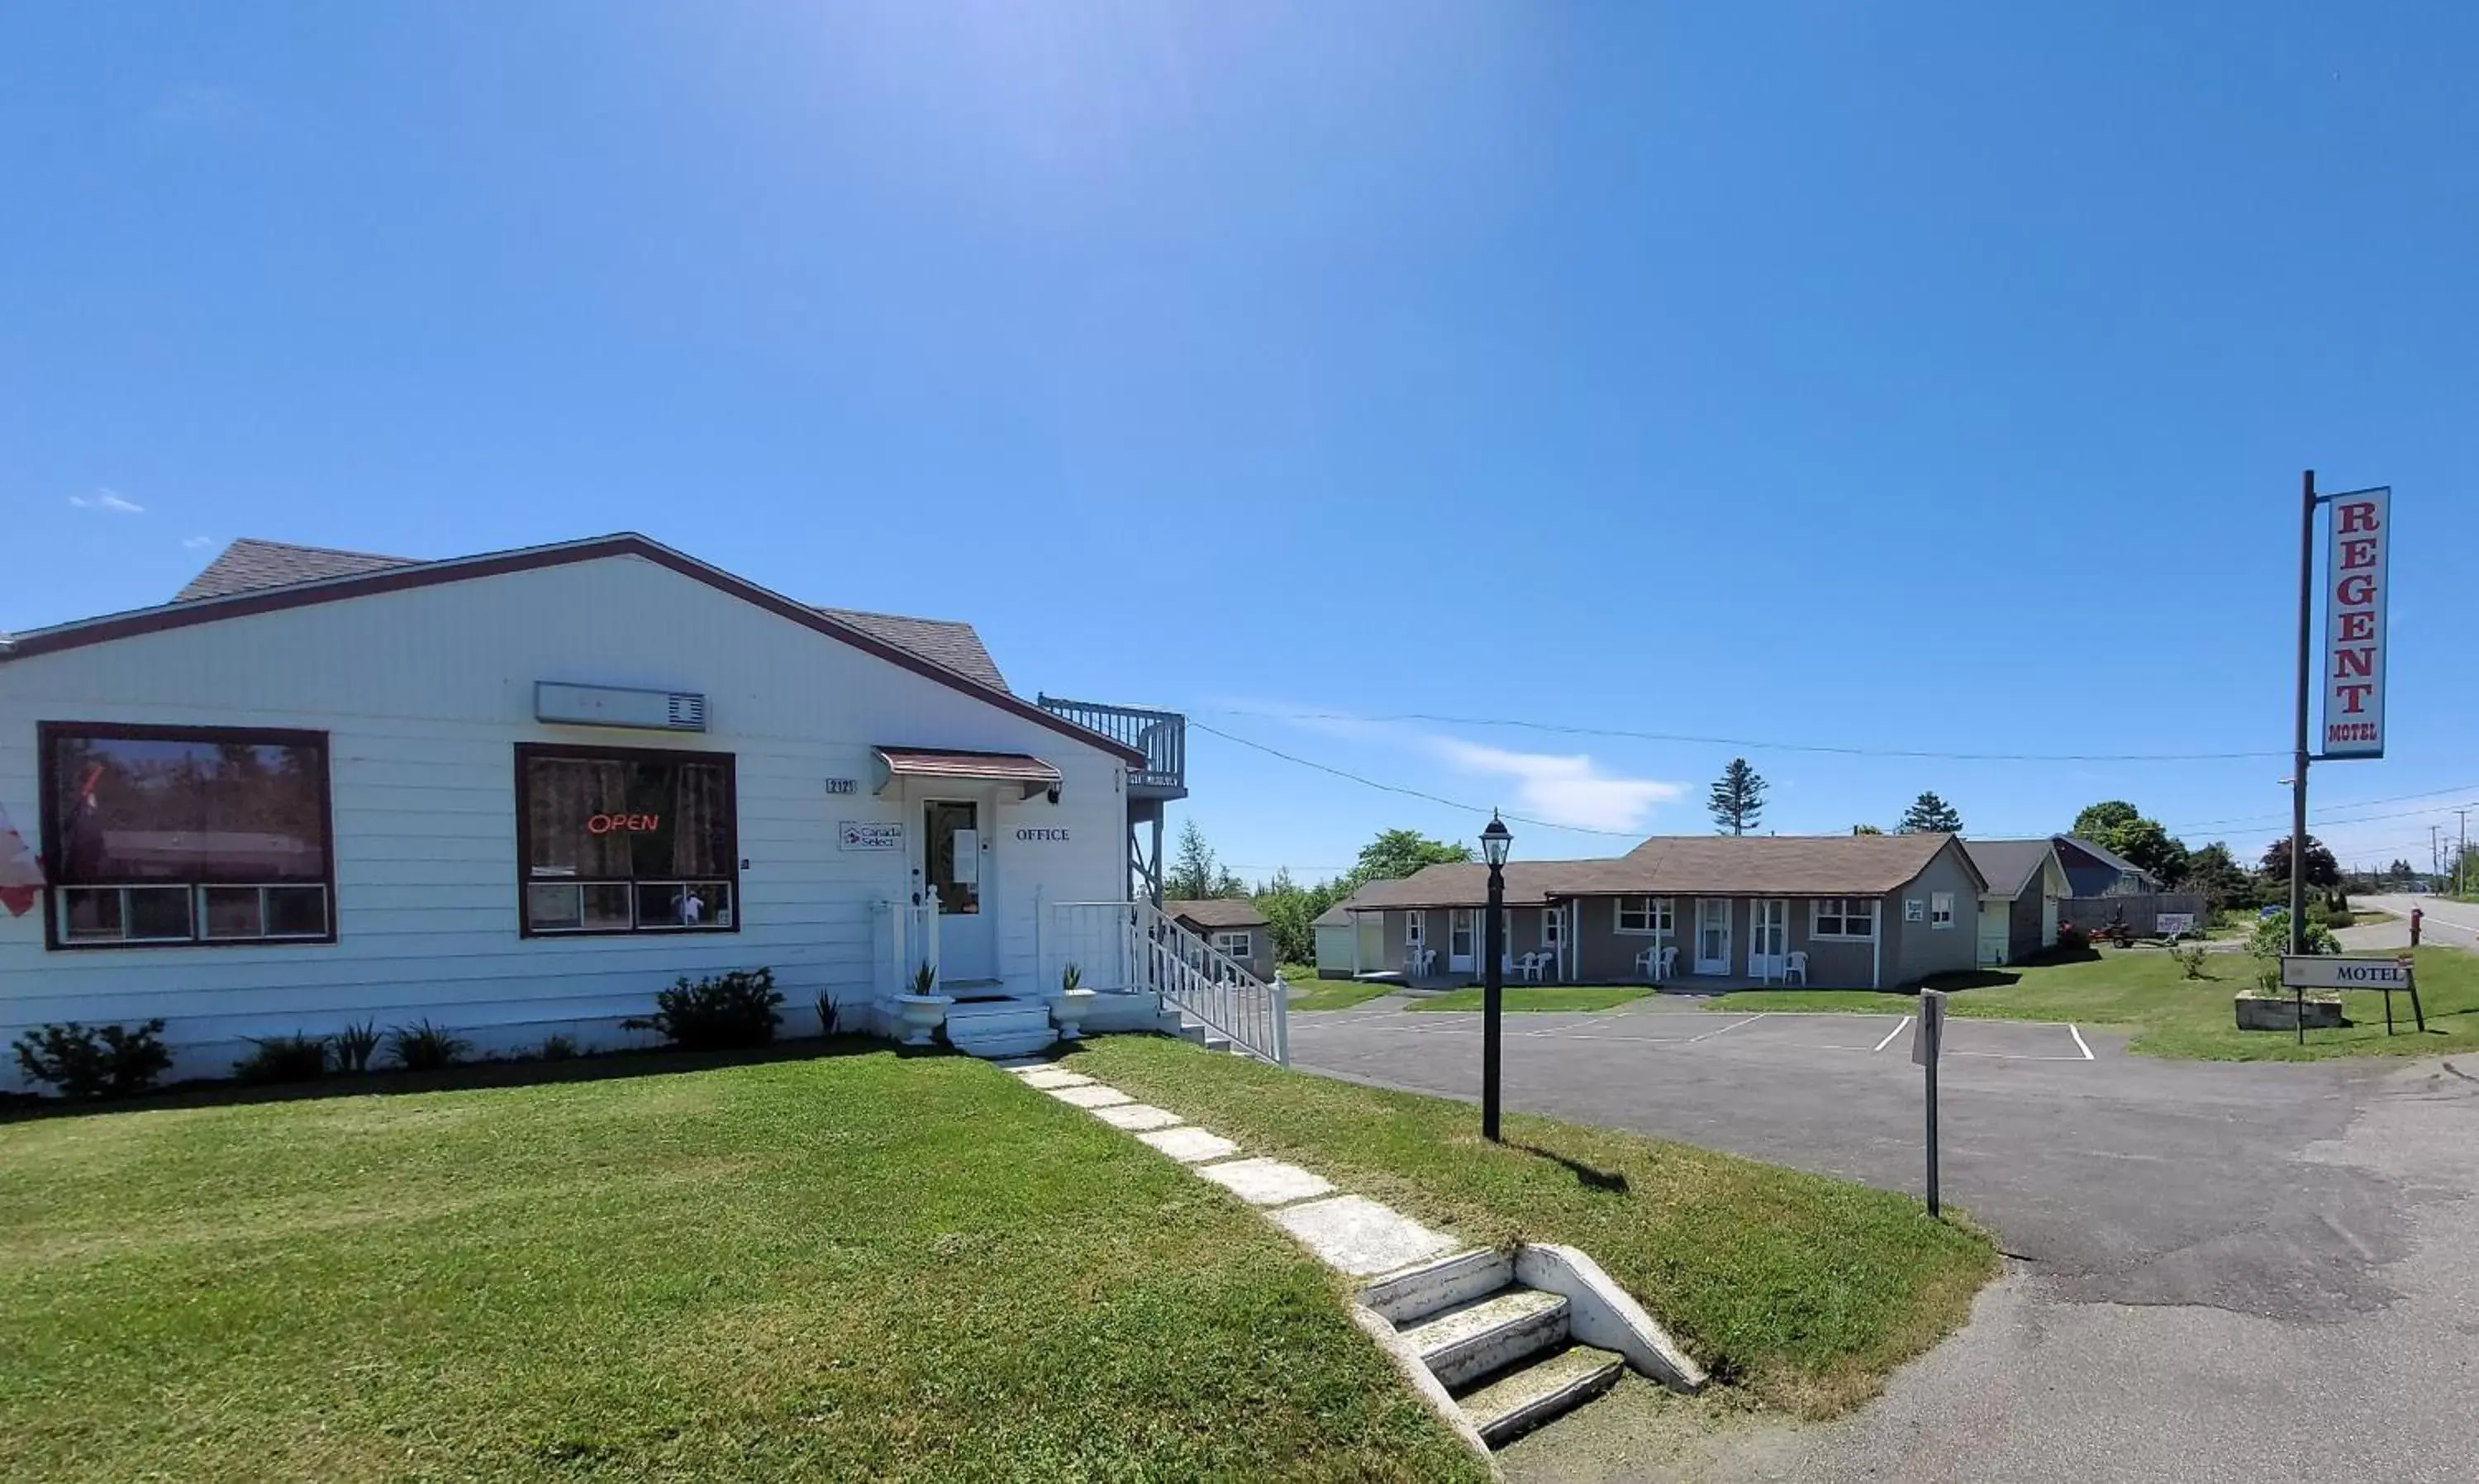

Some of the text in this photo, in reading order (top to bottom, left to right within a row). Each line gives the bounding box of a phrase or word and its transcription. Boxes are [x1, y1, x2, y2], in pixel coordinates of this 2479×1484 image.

[2334, 502, 2380, 713] REGENT
[2329, 723, 2377, 742] MOTEL
[588, 814, 659, 834] OPEN
[862, 827, 902, 837] Canada
[1016, 828, 1070, 840] OFFICE
[862, 837, 893, 847] Select
[2337, 967, 2405, 982] MOTEL
